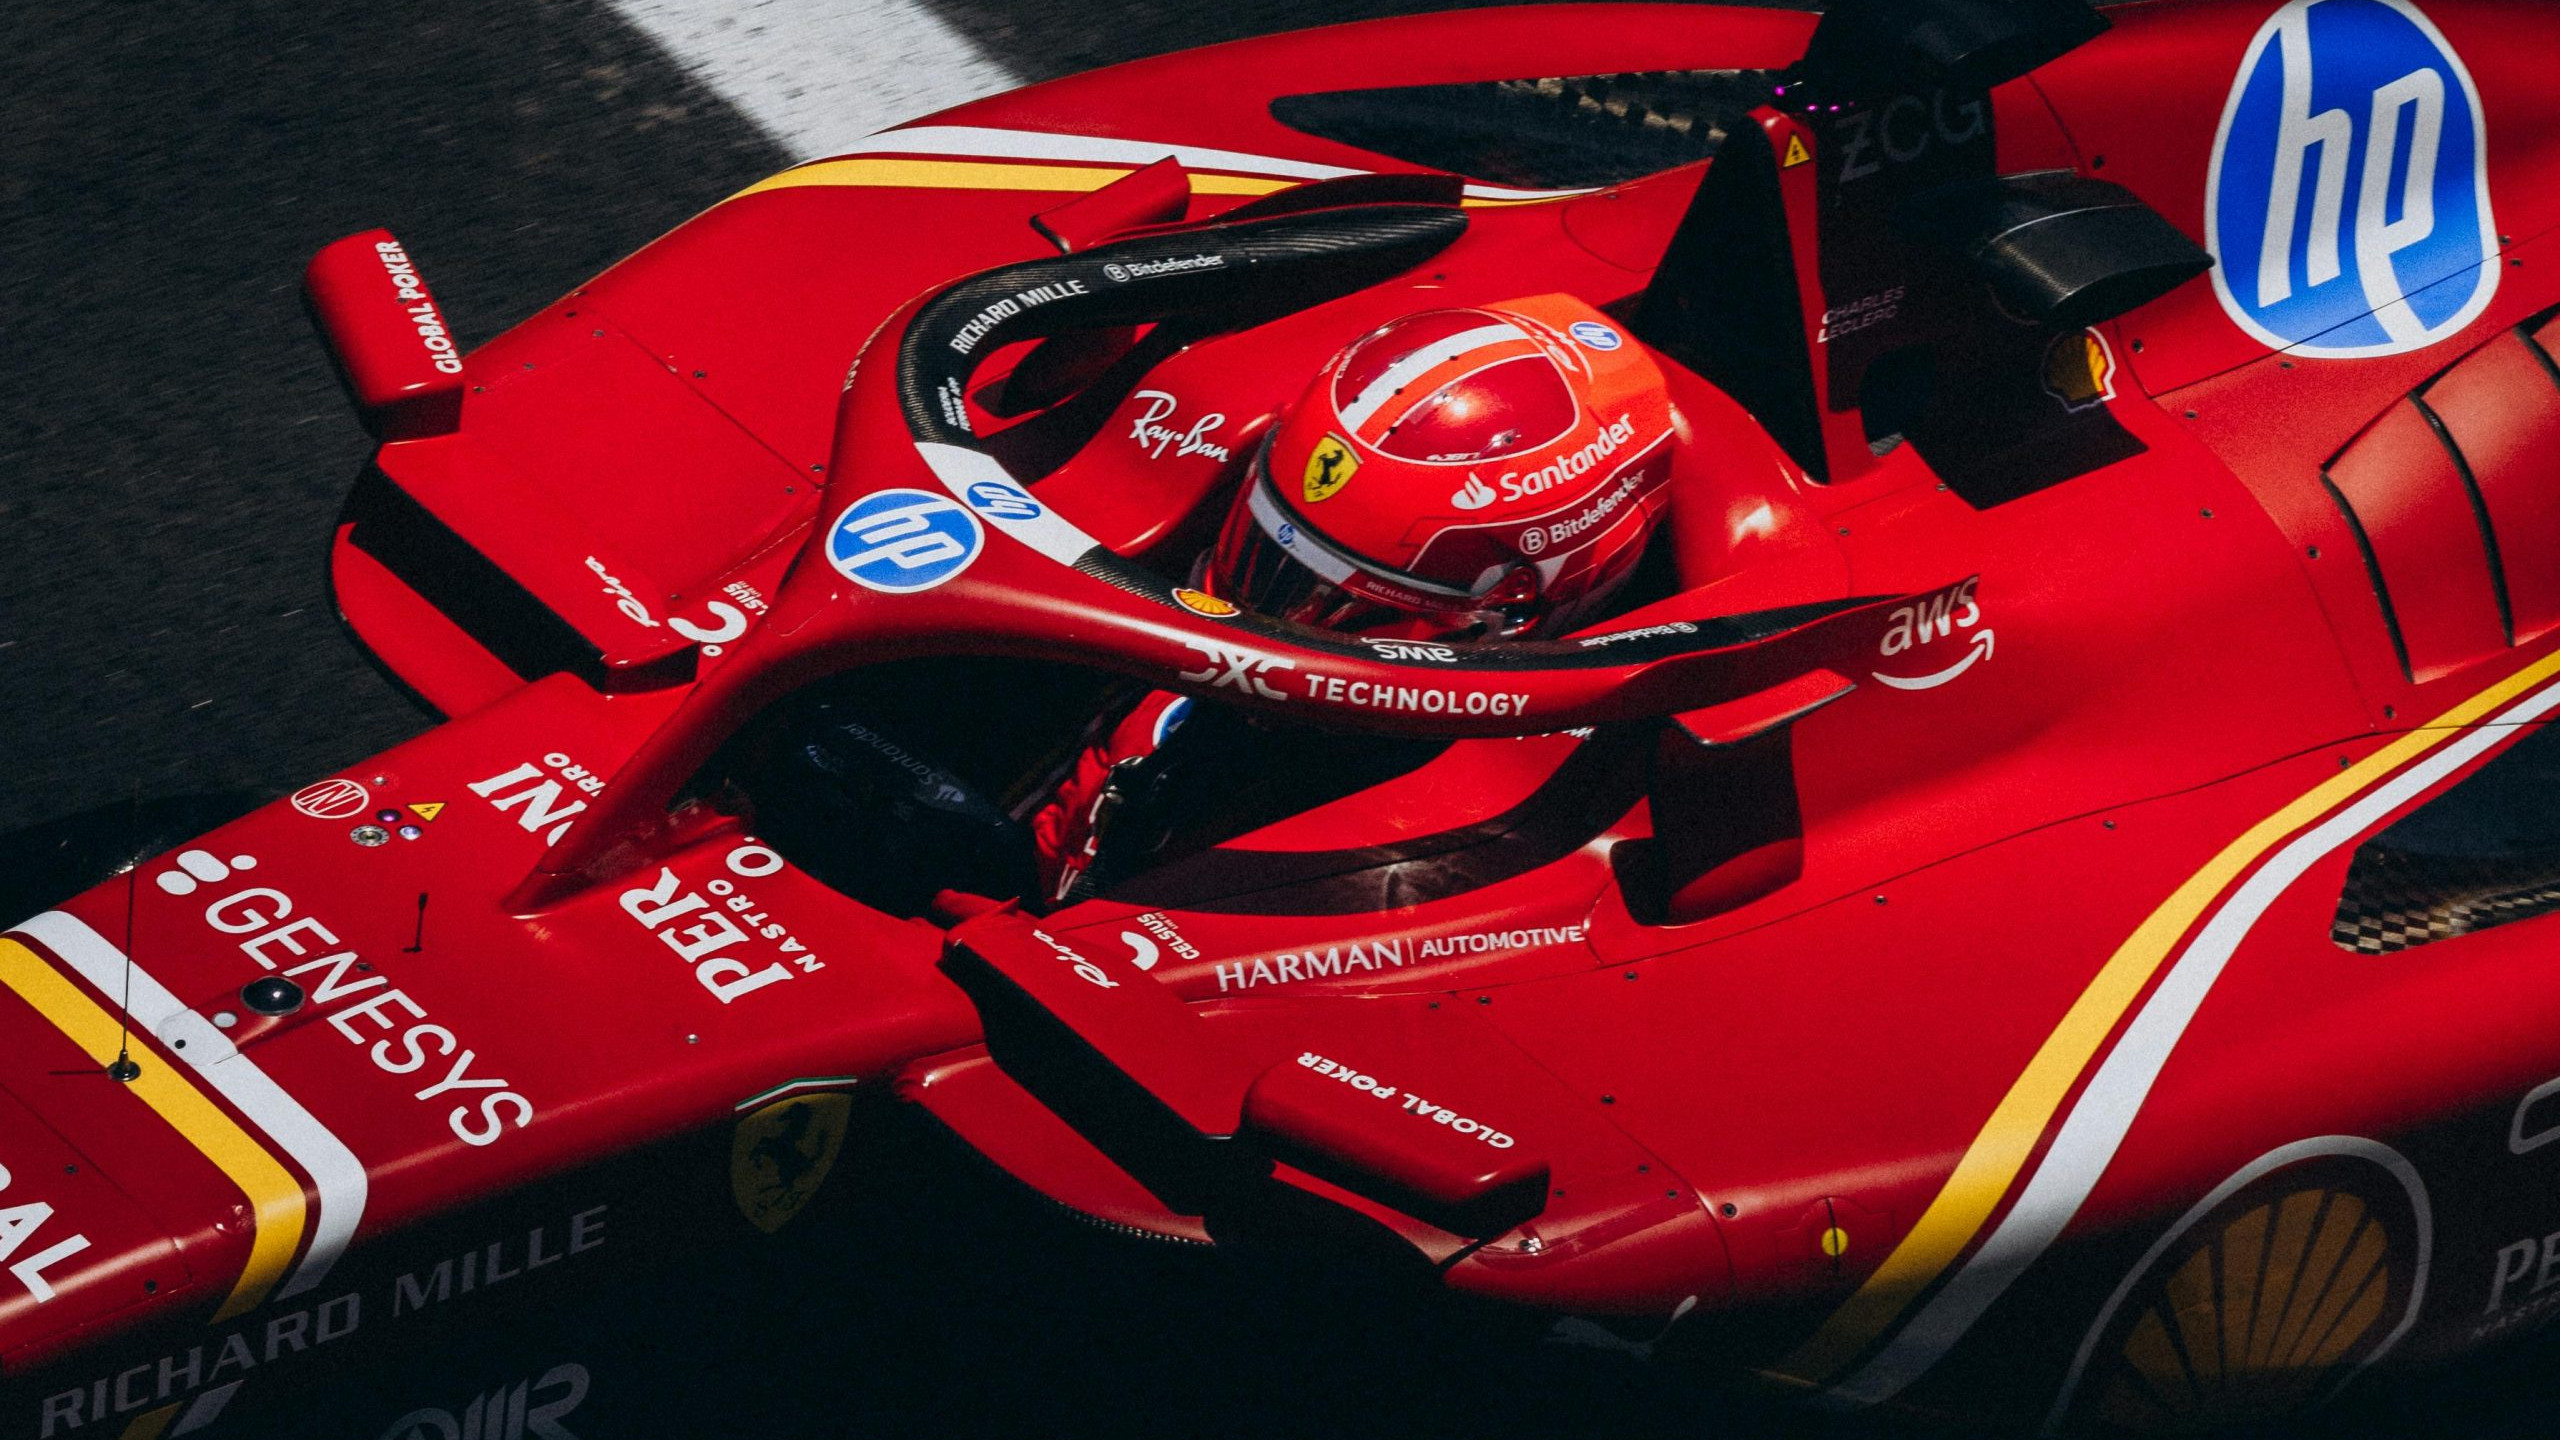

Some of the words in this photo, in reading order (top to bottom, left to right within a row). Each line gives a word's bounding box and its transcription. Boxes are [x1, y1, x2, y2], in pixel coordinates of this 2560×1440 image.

[2250, 0, 2458, 347] hp
[375, 241, 427, 300] POKER
[1126, 253, 1225, 278] Bitdefender
[407, 302, 463, 374] GLOBAL
[949, 298, 1021, 355] RICHARD
[1016, 279, 1091, 309] MILLE
[1816, 303, 1898, 344] LECLERC
[1821, 284, 1906, 325] CHARLES
[1499, 413, 1636, 503] Santander
[837, 494, 976, 579] hp
[968, 483, 1041, 520] hp
[1548, 468, 1647, 545] Bitdefender
[1579, 623, 1678, 648] Bitdefender
[1879, 575, 1980, 657] aws
[1178, 640, 1296, 701] DXC
[1304, 673, 1531, 716] TECHNOLOGY
[1371, 643, 1459, 662] aws
[706, 878, 826, 974] NASTRO
[1137, 913, 1200, 960] CELSIUS
[1214, 938, 1402, 993] HARMAN
[1419, 924, 1586, 960] AUTOMOTIVE
[204, 886, 534, 1147] GENESYS
[1296, 1051, 1398, 1100] POKER
[1401, 1092, 1515, 1149] GLOBAL
[39, 1292, 362, 1440] RICHARD
[392, 1204, 610, 1319] MILLE
